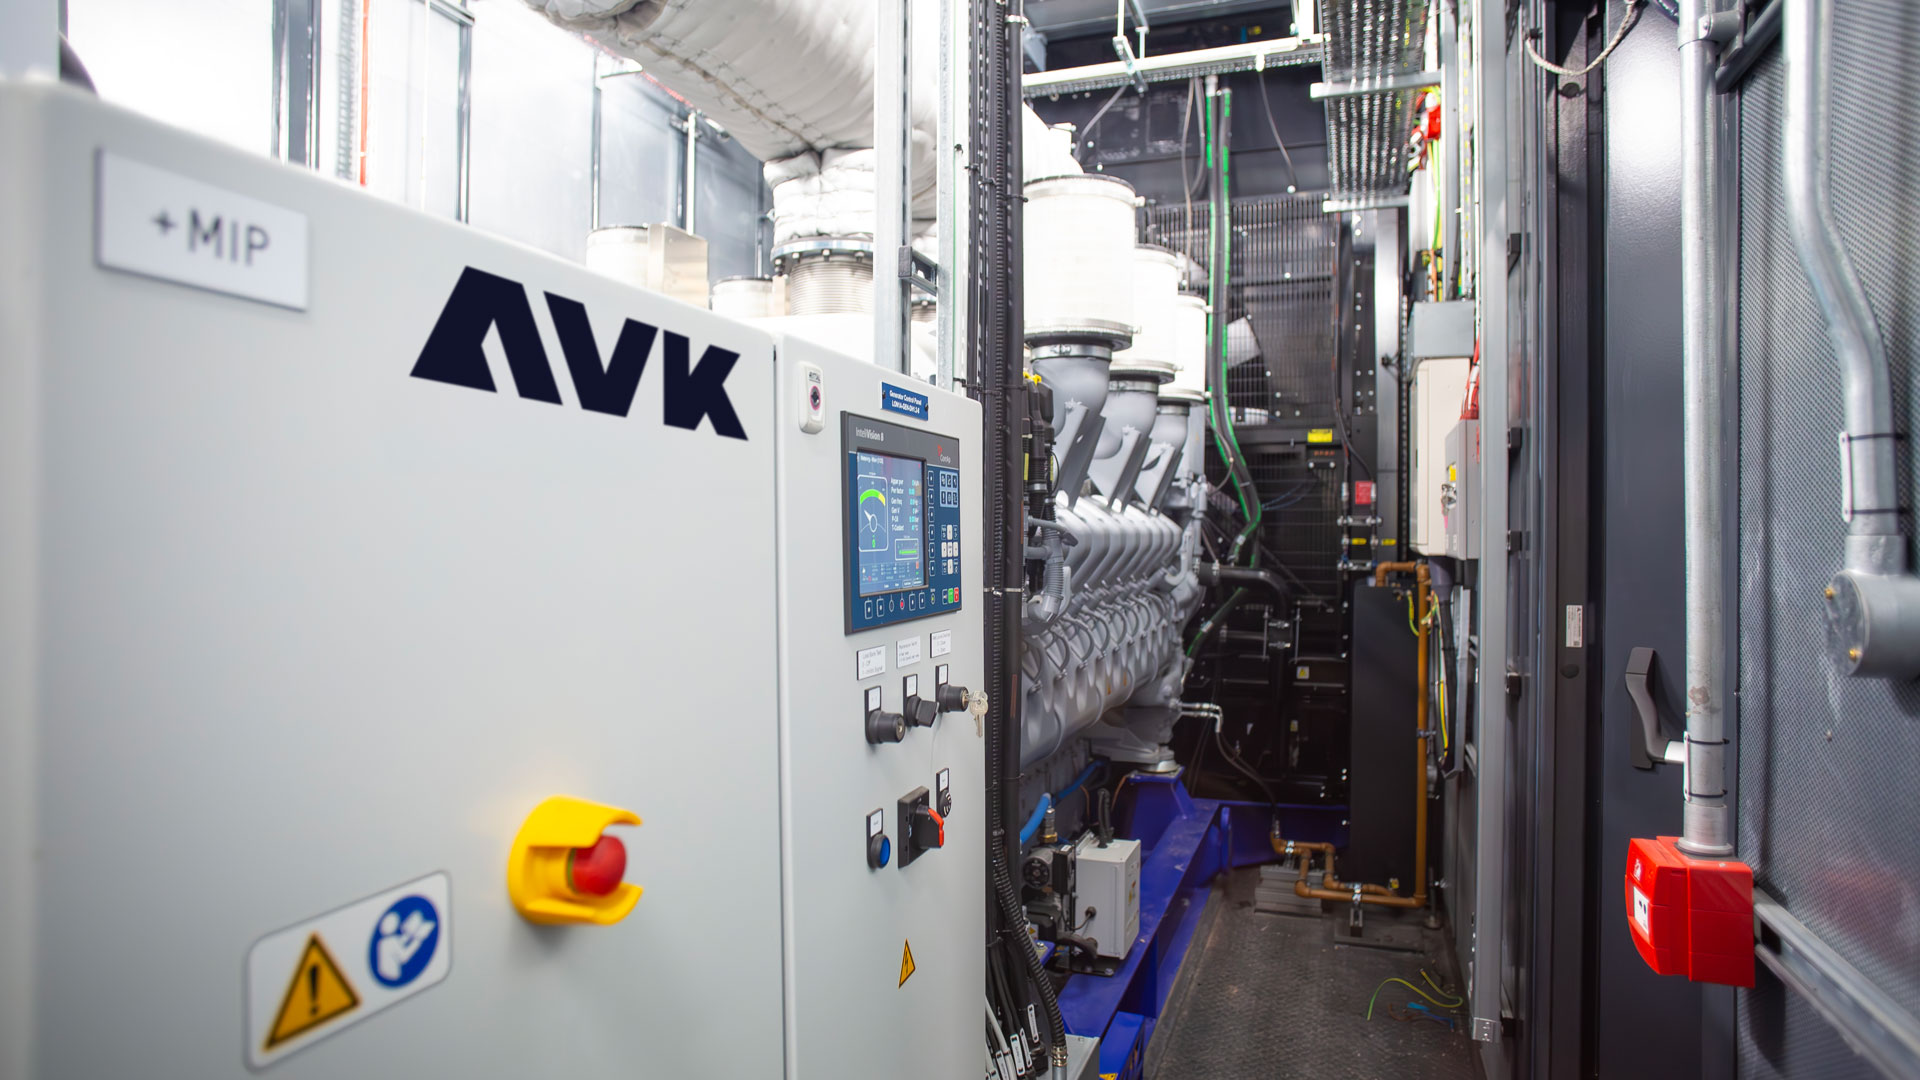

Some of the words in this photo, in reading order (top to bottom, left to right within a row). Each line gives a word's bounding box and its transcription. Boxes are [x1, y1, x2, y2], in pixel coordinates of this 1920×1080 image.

[410, 265, 749, 441] AVK
[889, 390, 904, 400] Generator
[904, 394, 914, 403] Control
